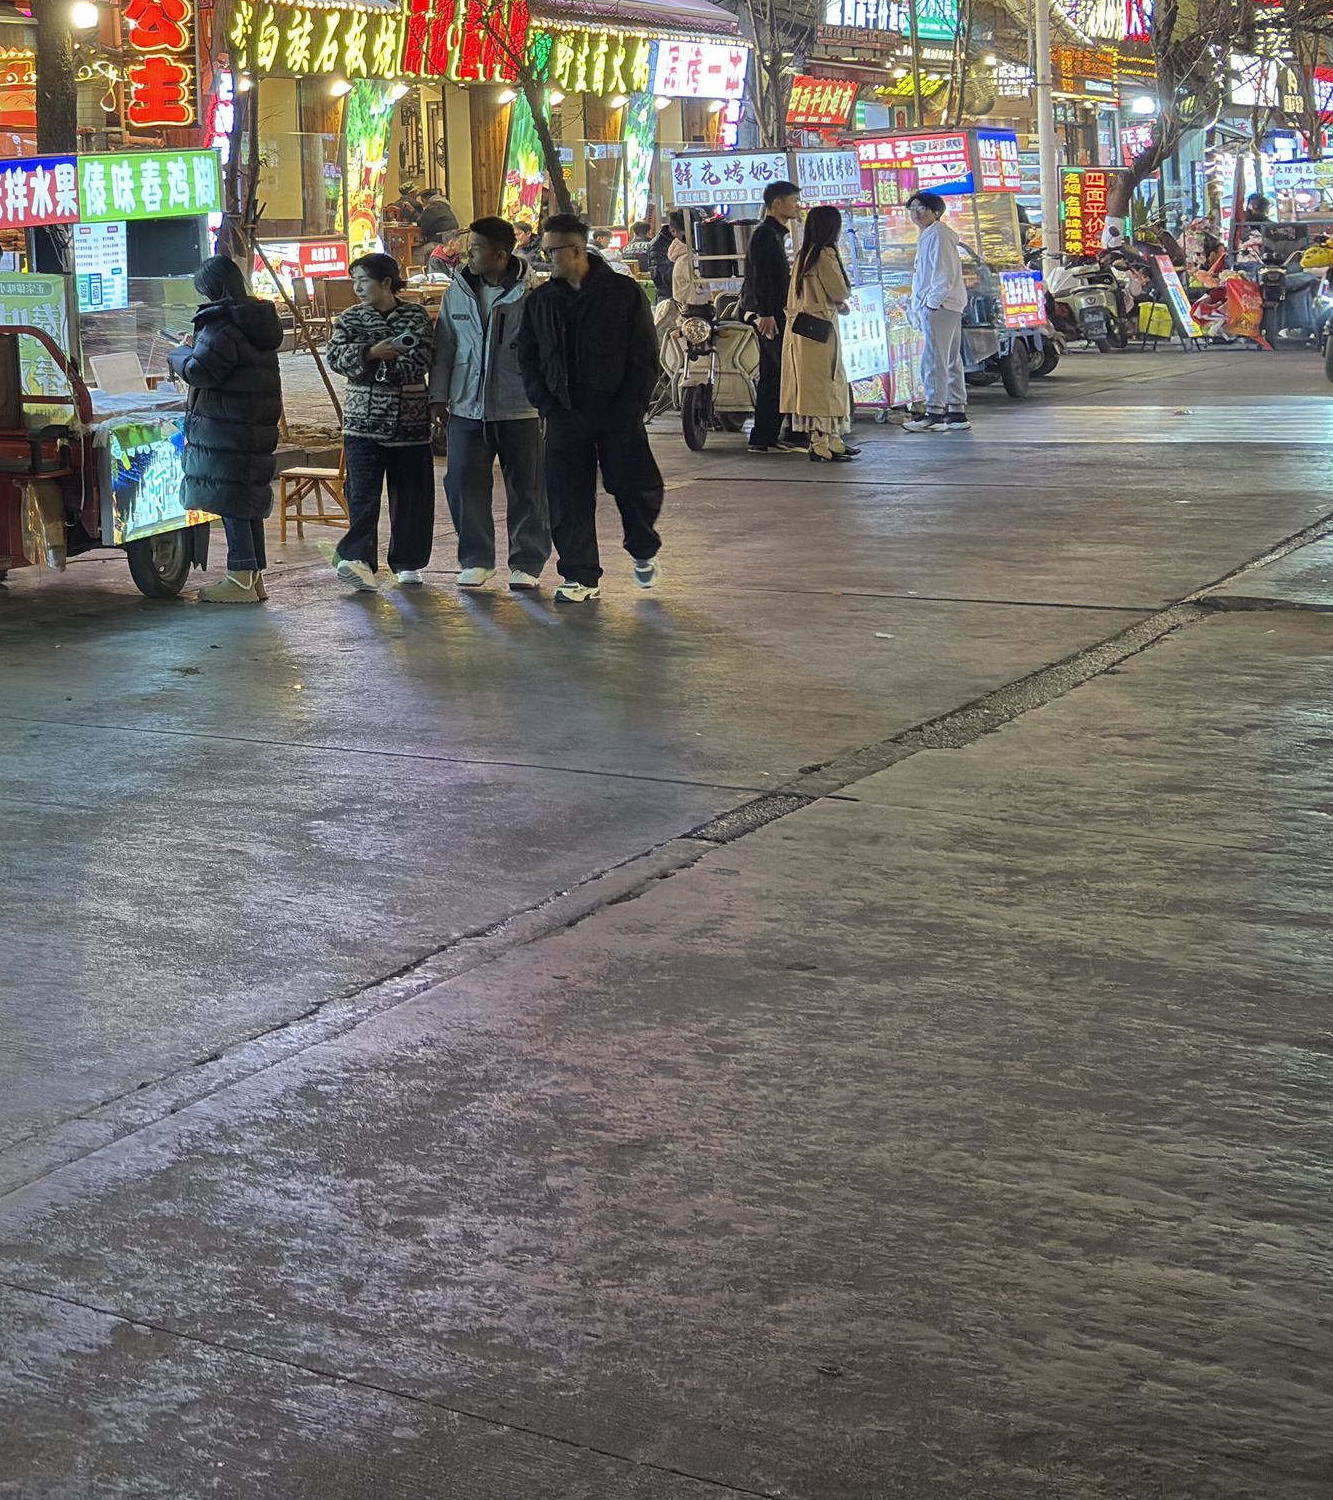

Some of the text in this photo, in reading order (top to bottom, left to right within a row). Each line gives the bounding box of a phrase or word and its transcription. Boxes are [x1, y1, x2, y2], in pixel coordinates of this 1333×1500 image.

[789, 85, 853, 119] 四面平价超市
[858, 141, 911, 161] 烤虫子
[674, 160, 773, 189] 鲜花烤奶
